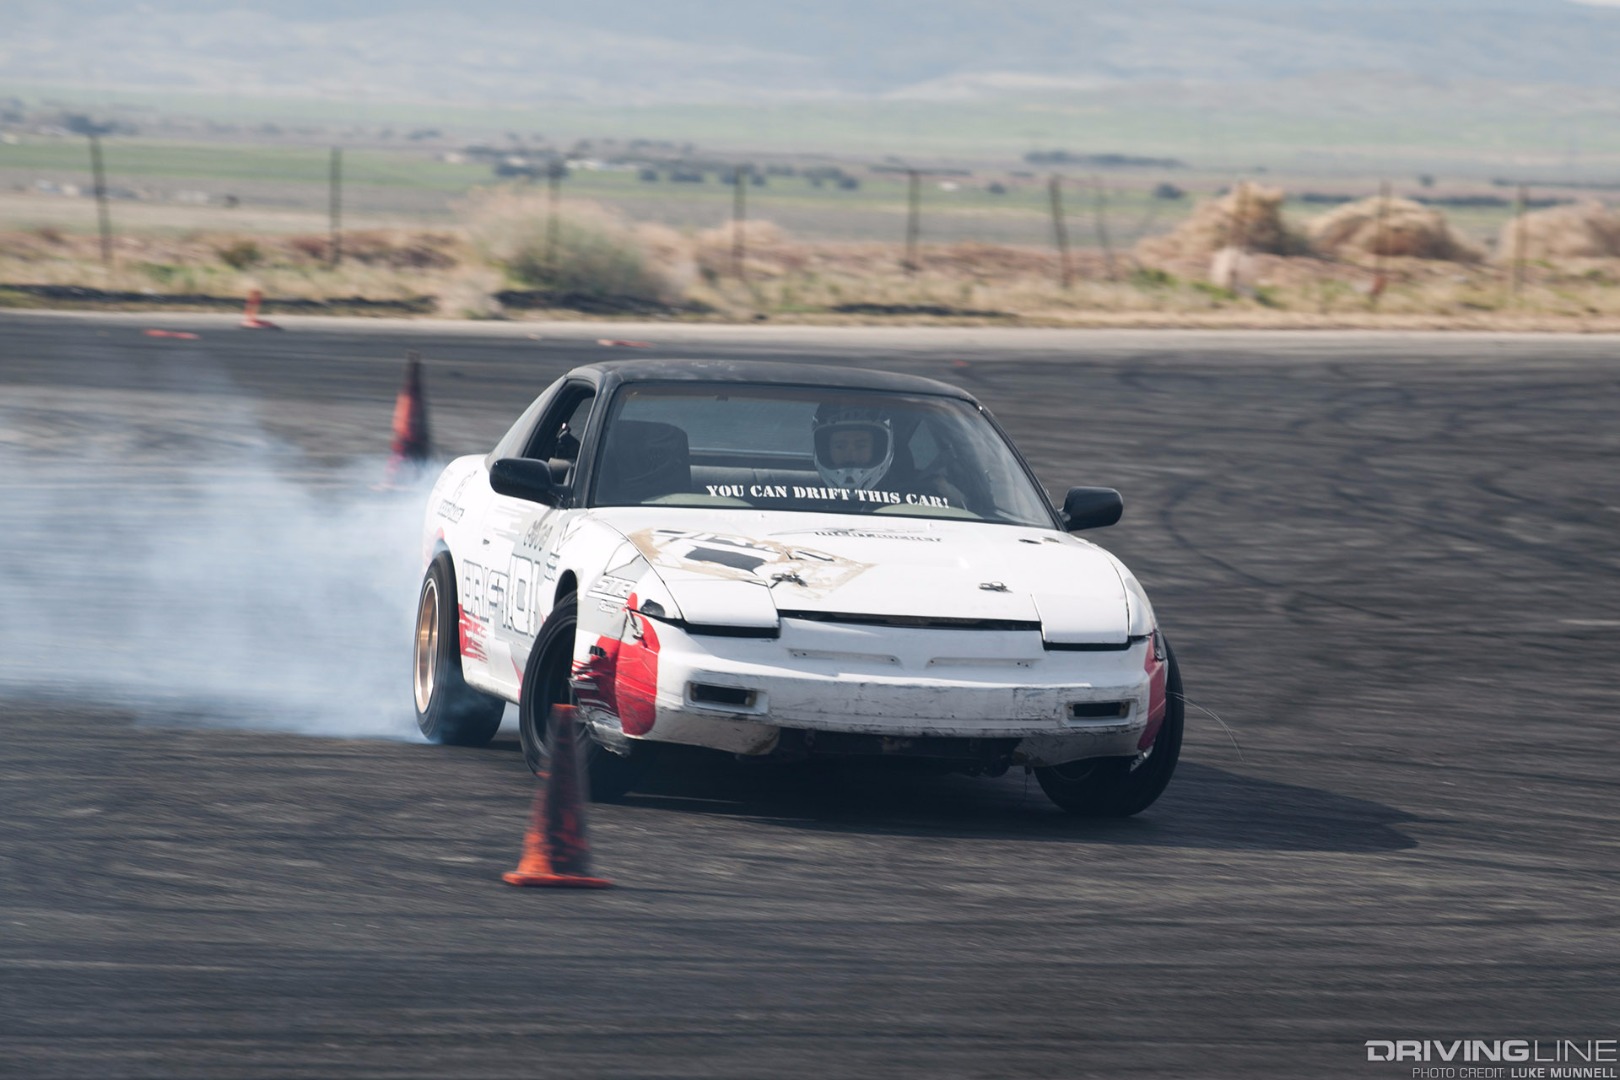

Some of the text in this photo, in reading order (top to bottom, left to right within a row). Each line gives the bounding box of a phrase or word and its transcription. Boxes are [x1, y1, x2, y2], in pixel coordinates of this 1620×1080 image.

[705, 485, 950, 509] YOU CAN DRIFT THIS CAR!
